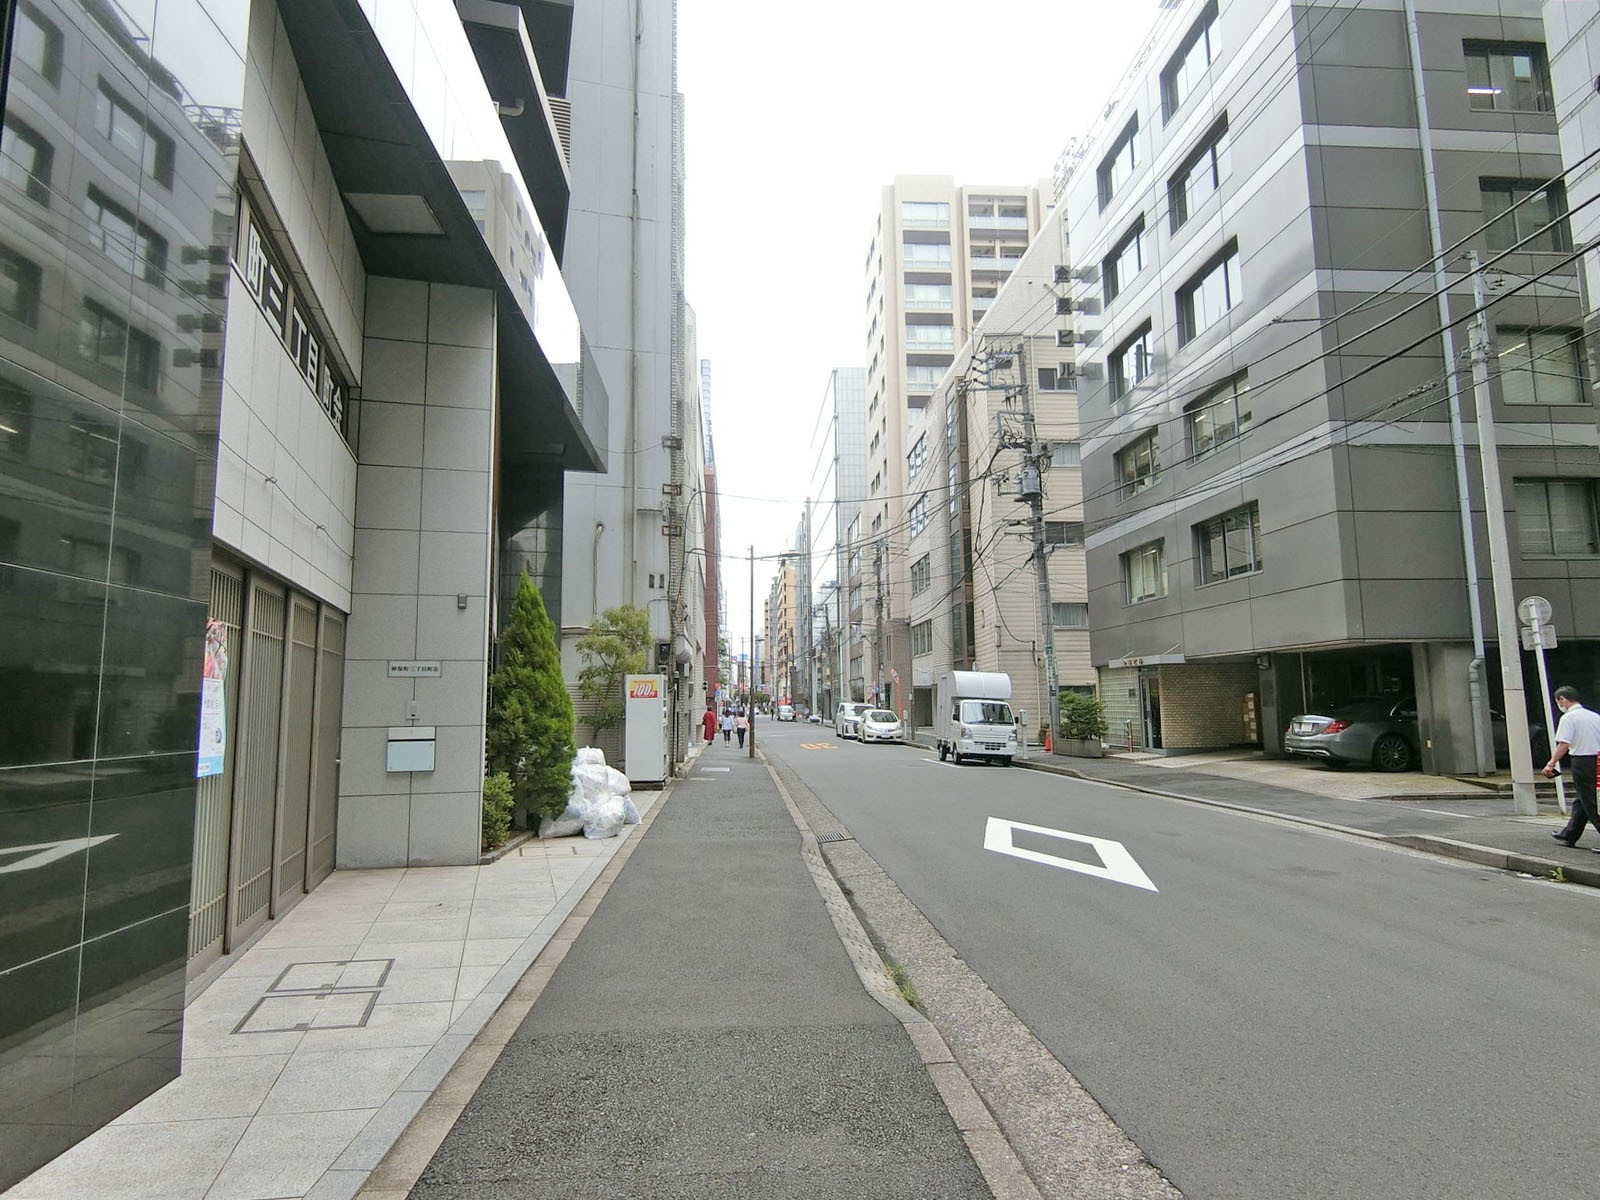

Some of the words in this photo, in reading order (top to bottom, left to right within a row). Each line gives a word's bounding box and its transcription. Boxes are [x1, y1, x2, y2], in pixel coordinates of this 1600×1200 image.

[246, 222, 343, 432] 町三丁目町会
